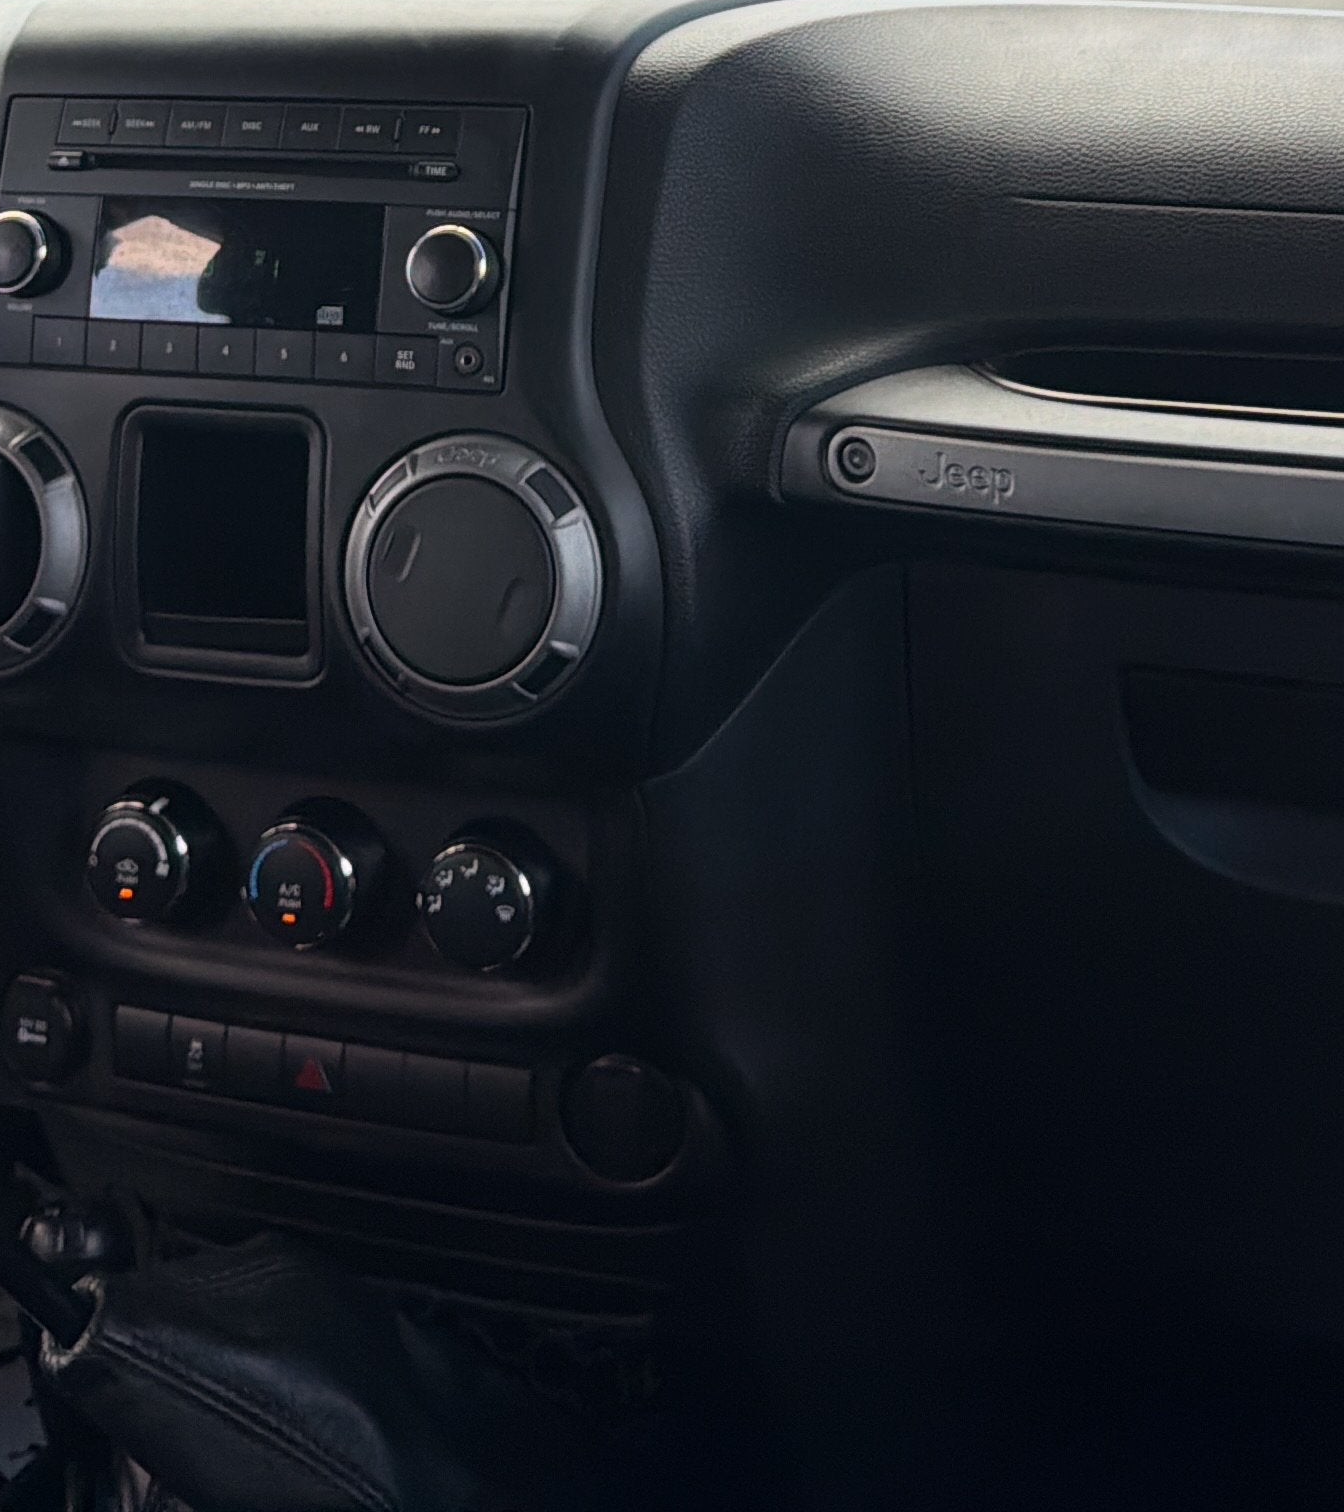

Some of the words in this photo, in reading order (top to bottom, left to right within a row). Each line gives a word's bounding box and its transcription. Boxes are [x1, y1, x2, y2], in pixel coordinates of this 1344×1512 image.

[180, 120, 213, 130] AM/FM
[241, 121, 263, 131] DISC
[301, 122, 320, 132] AUX
[365, 124, 381, 135] RW
[418, 124, 431, 135] FF
[425, 167, 447, 177] TIME
[396, 350, 415, 361] SET
[918, 451, 1016, 506] Jeep
